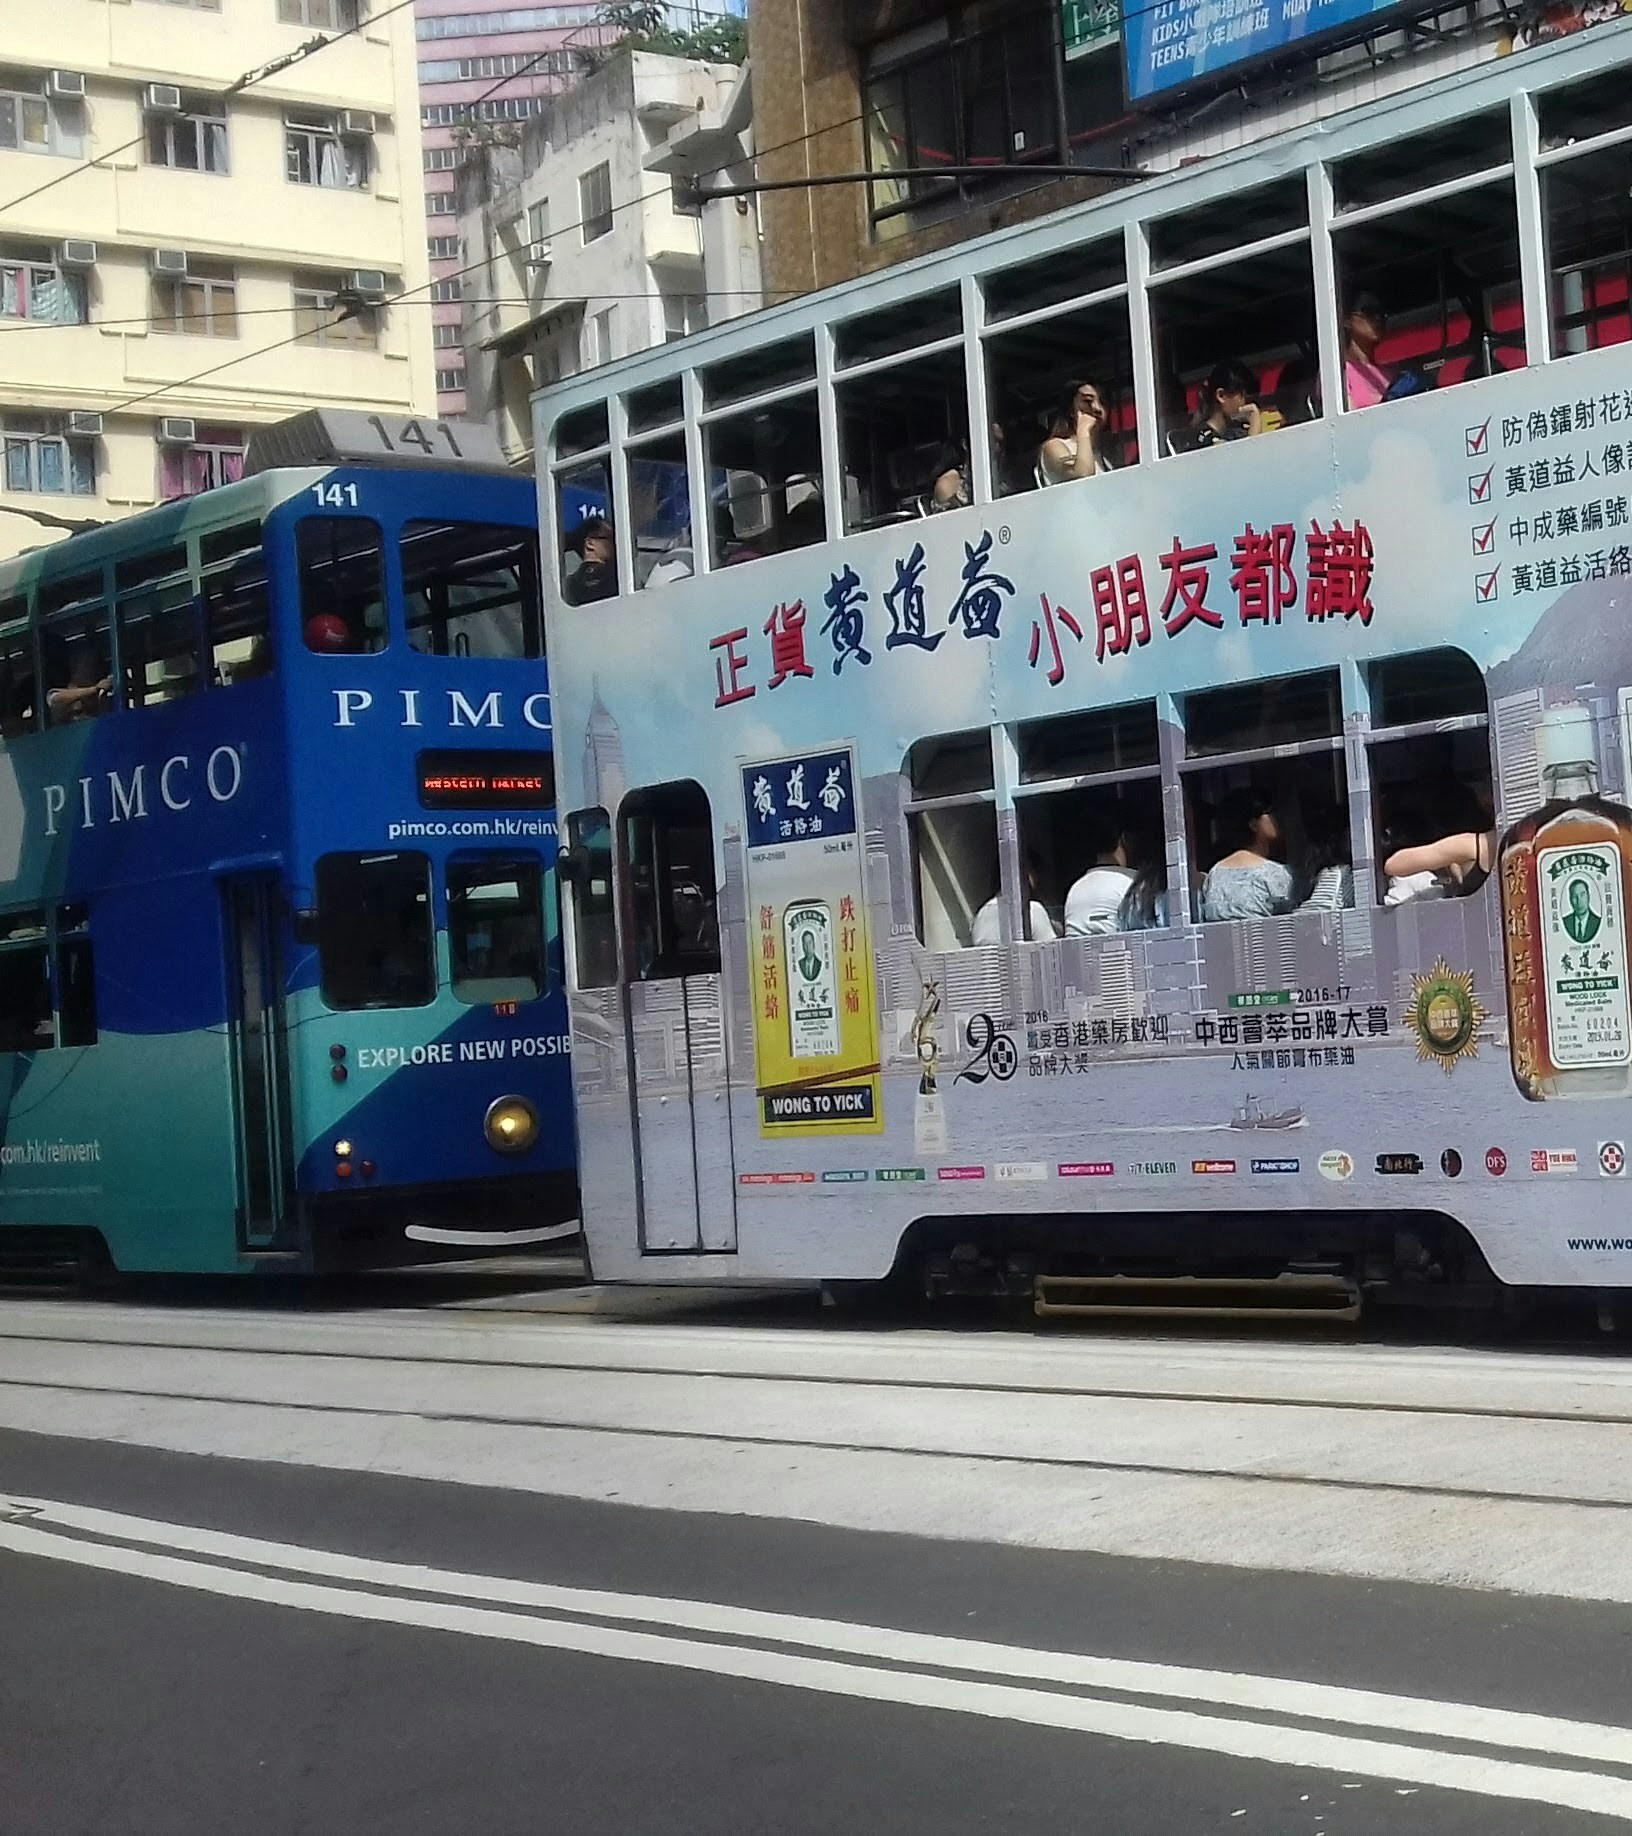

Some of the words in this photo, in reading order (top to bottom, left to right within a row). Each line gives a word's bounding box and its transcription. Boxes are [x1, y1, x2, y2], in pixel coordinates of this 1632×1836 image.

[367, 415, 466, 460] 141
[312, 483, 359, 508] 141
[44, 745, 243, 836] PIMCO
[1297, 986, 1351, 1003] 2016-17
[1026, 1011, 1049, 1024] 2016
[357, 1043, 454, 1069] EXPLORE
[459, 1040, 506, 1063] NEW
[772, 1096, 811, 1115] WONG
[815, 1095, 832, 1113] TO
[832, 1093, 864, 1111] YICK
[1487, 1155, 1506, 1168] DFS
